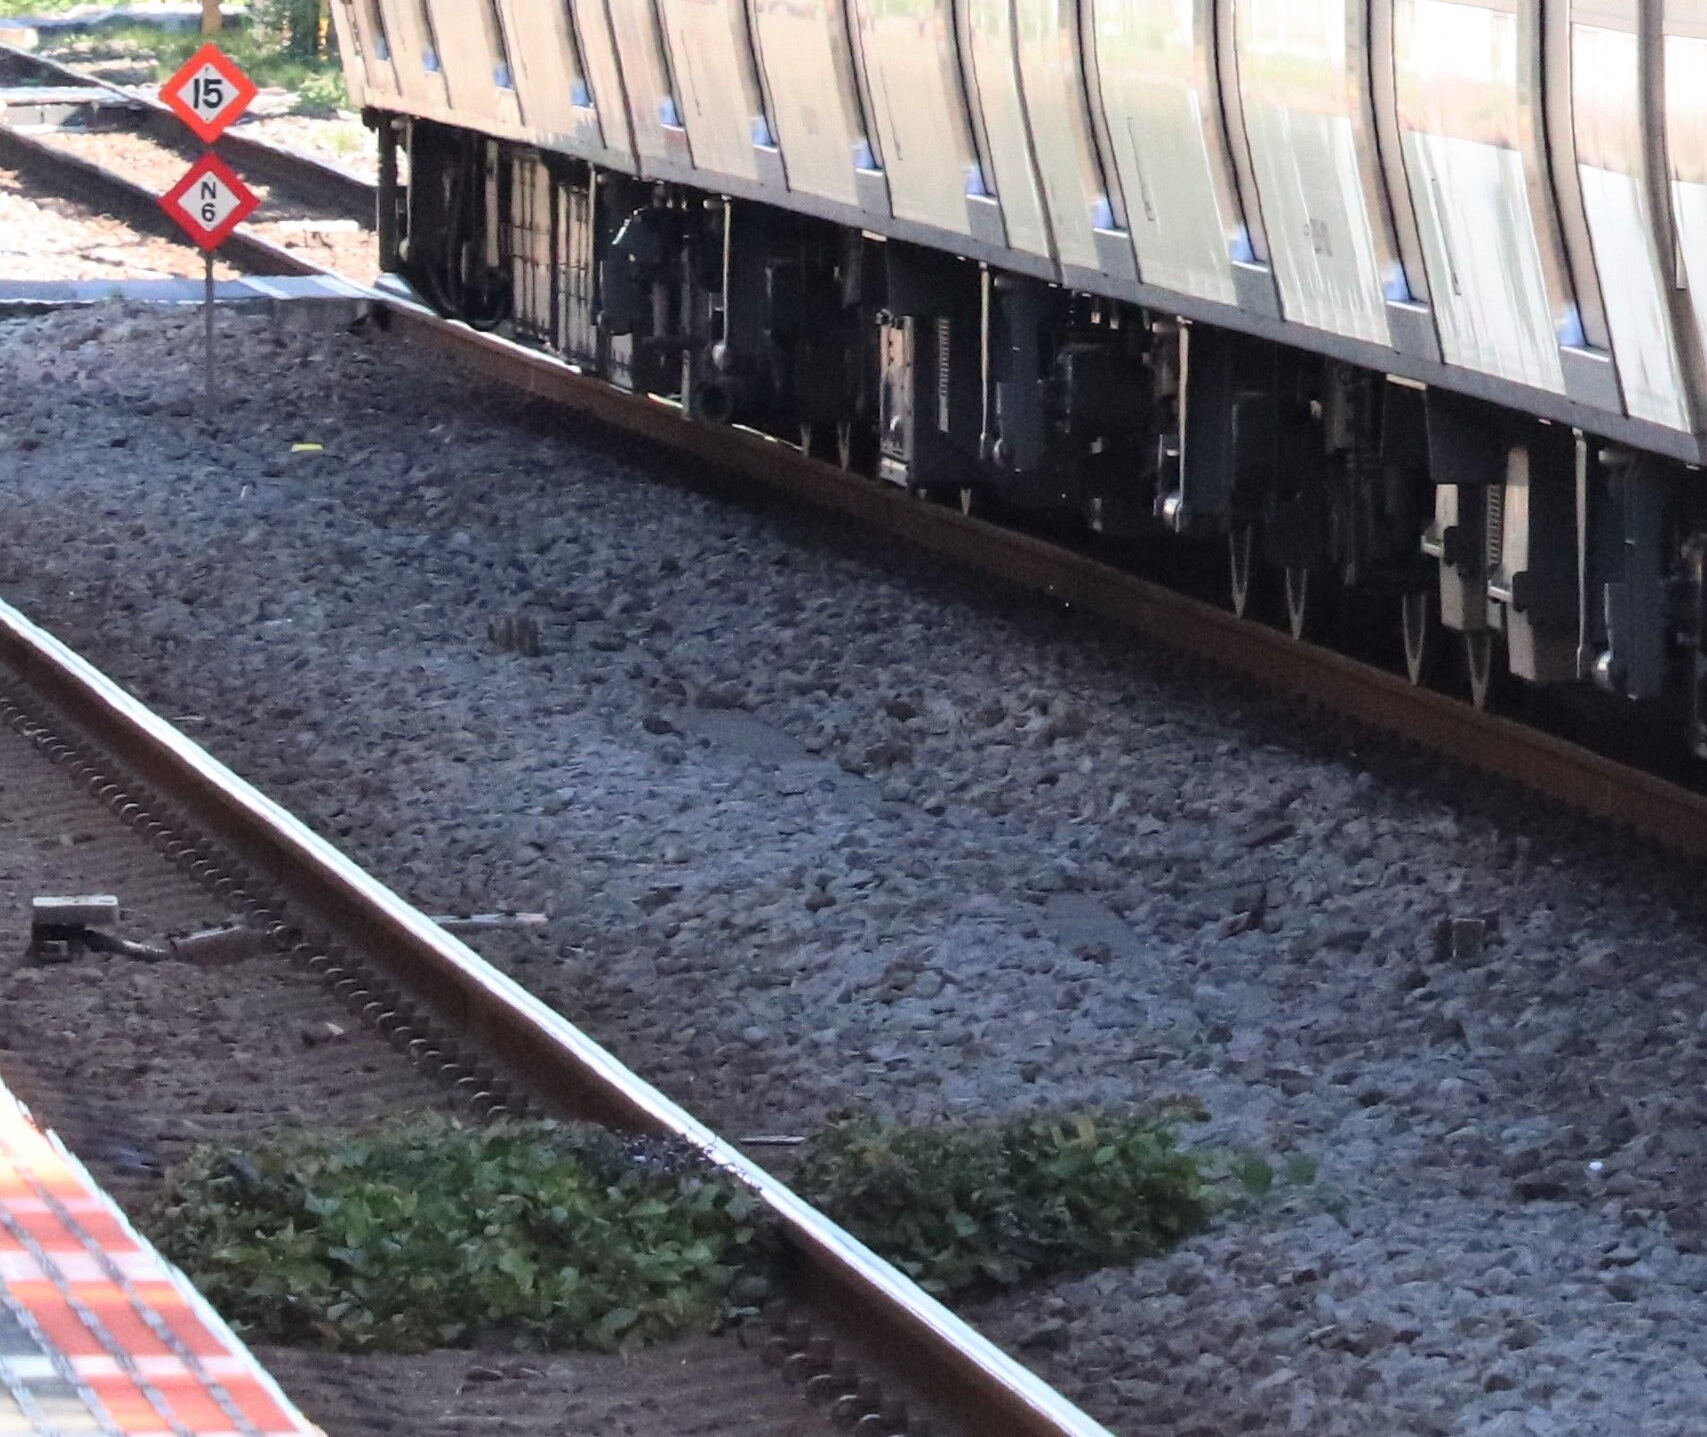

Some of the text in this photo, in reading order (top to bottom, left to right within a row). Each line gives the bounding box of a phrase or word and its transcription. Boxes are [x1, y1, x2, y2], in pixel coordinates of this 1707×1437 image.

[192, 78, 224, 109] 15
[200, 181, 217, 200] N
[200, 202, 217, 223] 6
